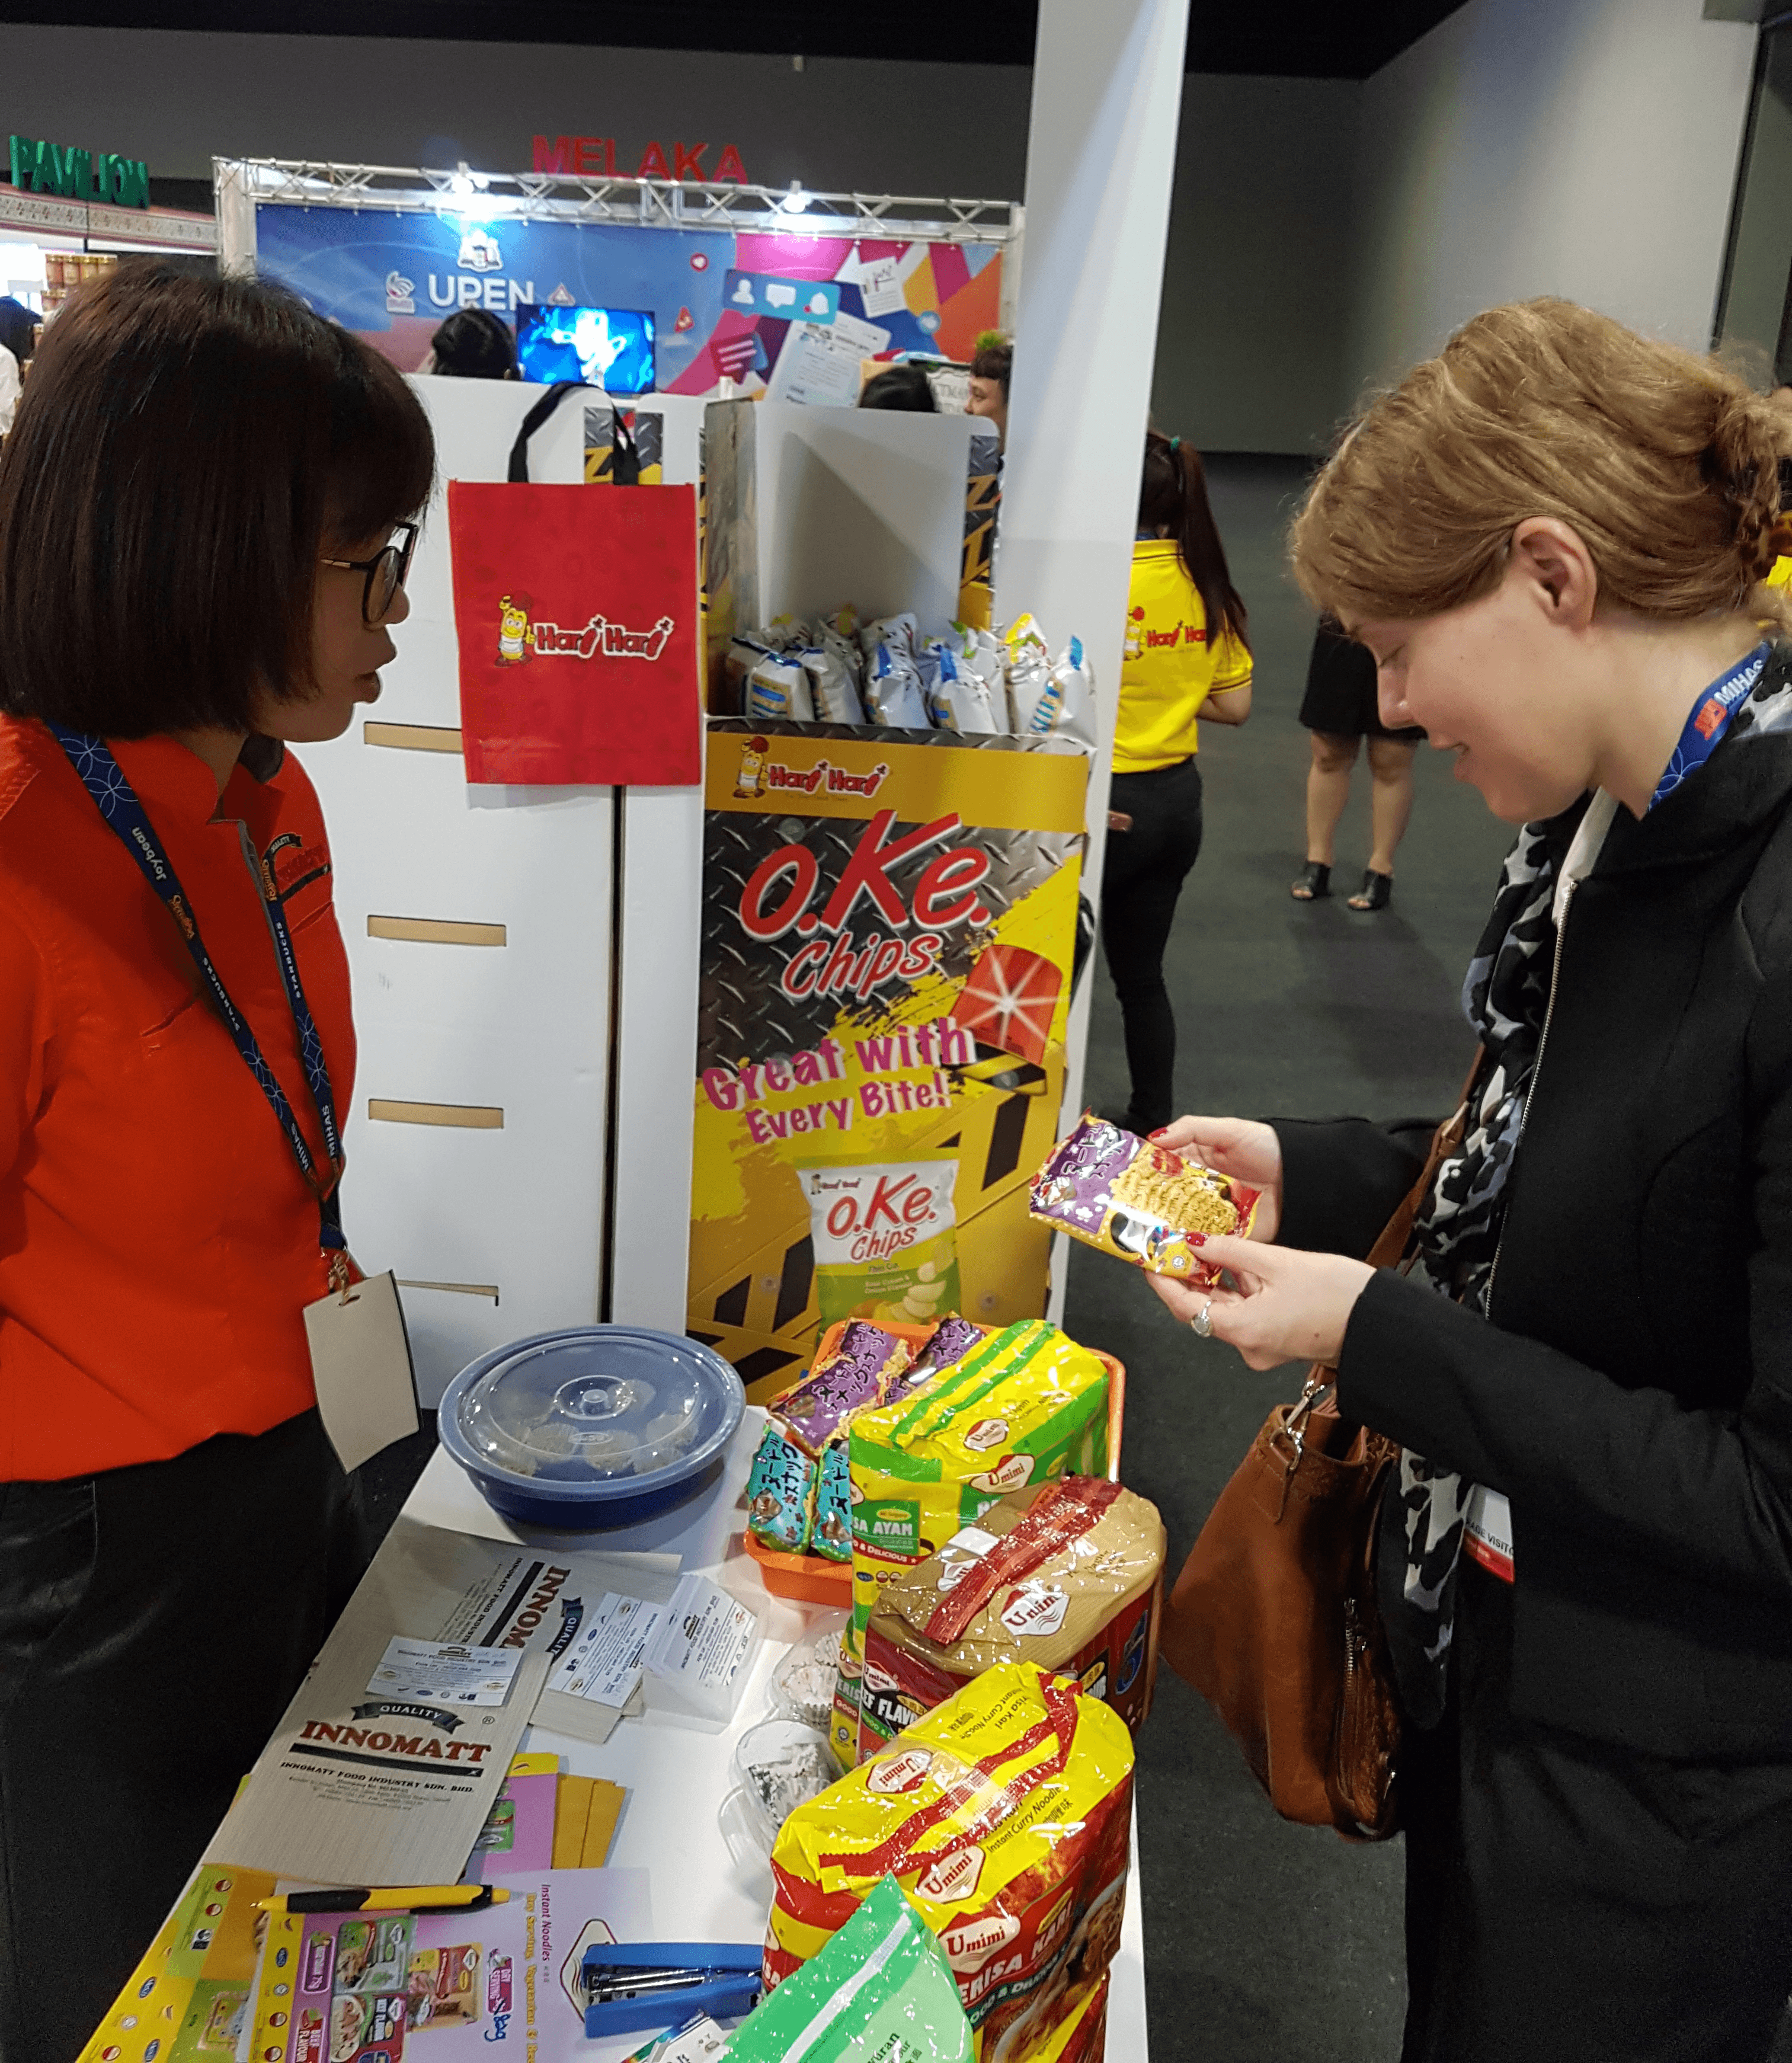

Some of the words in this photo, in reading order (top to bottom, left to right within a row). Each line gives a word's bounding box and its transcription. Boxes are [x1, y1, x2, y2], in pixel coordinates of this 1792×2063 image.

[533, 135, 748, 184] MELAKA
[132, 826, 167, 882] Joybean
[276, 922, 302, 999] STARBUCKS
[782, 932, 942, 1002] Chips
[702, 1038, 847, 1111] Great
[855, 1017, 976, 1073] with
[747, 1095, 853, 1144] Every
[859, 1070, 952, 1119] Bite!
[322, 1104, 336, 1157] MIHAS
[850, 1226, 918, 1262] Chips
[872, 1521, 913, 1536] AYAM
[379, 1704, 442, 1720] QUALITY
[981, 1702, 1004, 1723] Curry
[300, 1720, 492, 1764] INNOMATT
[280, 1761, 335, 1777] INNOMATT
[337, 1771, 367, 1783] FOOD
[367, 1777, 422, 1790] INDUSTRY
[878, 1755, 916, 1787] Umimi
[986, 1829, 1013, 1854] Instant
[1010, 1811, 1036, 1835] Curry
[1030, 1784, 1063, 1814] Noodle
[926, 1851, 973, 1895] Umimi
[540, 1883, 552, 1918] Instant
[540, 1920, 552, 1962] Noodles
[947, 1925, 1006, 1956] Umimi
